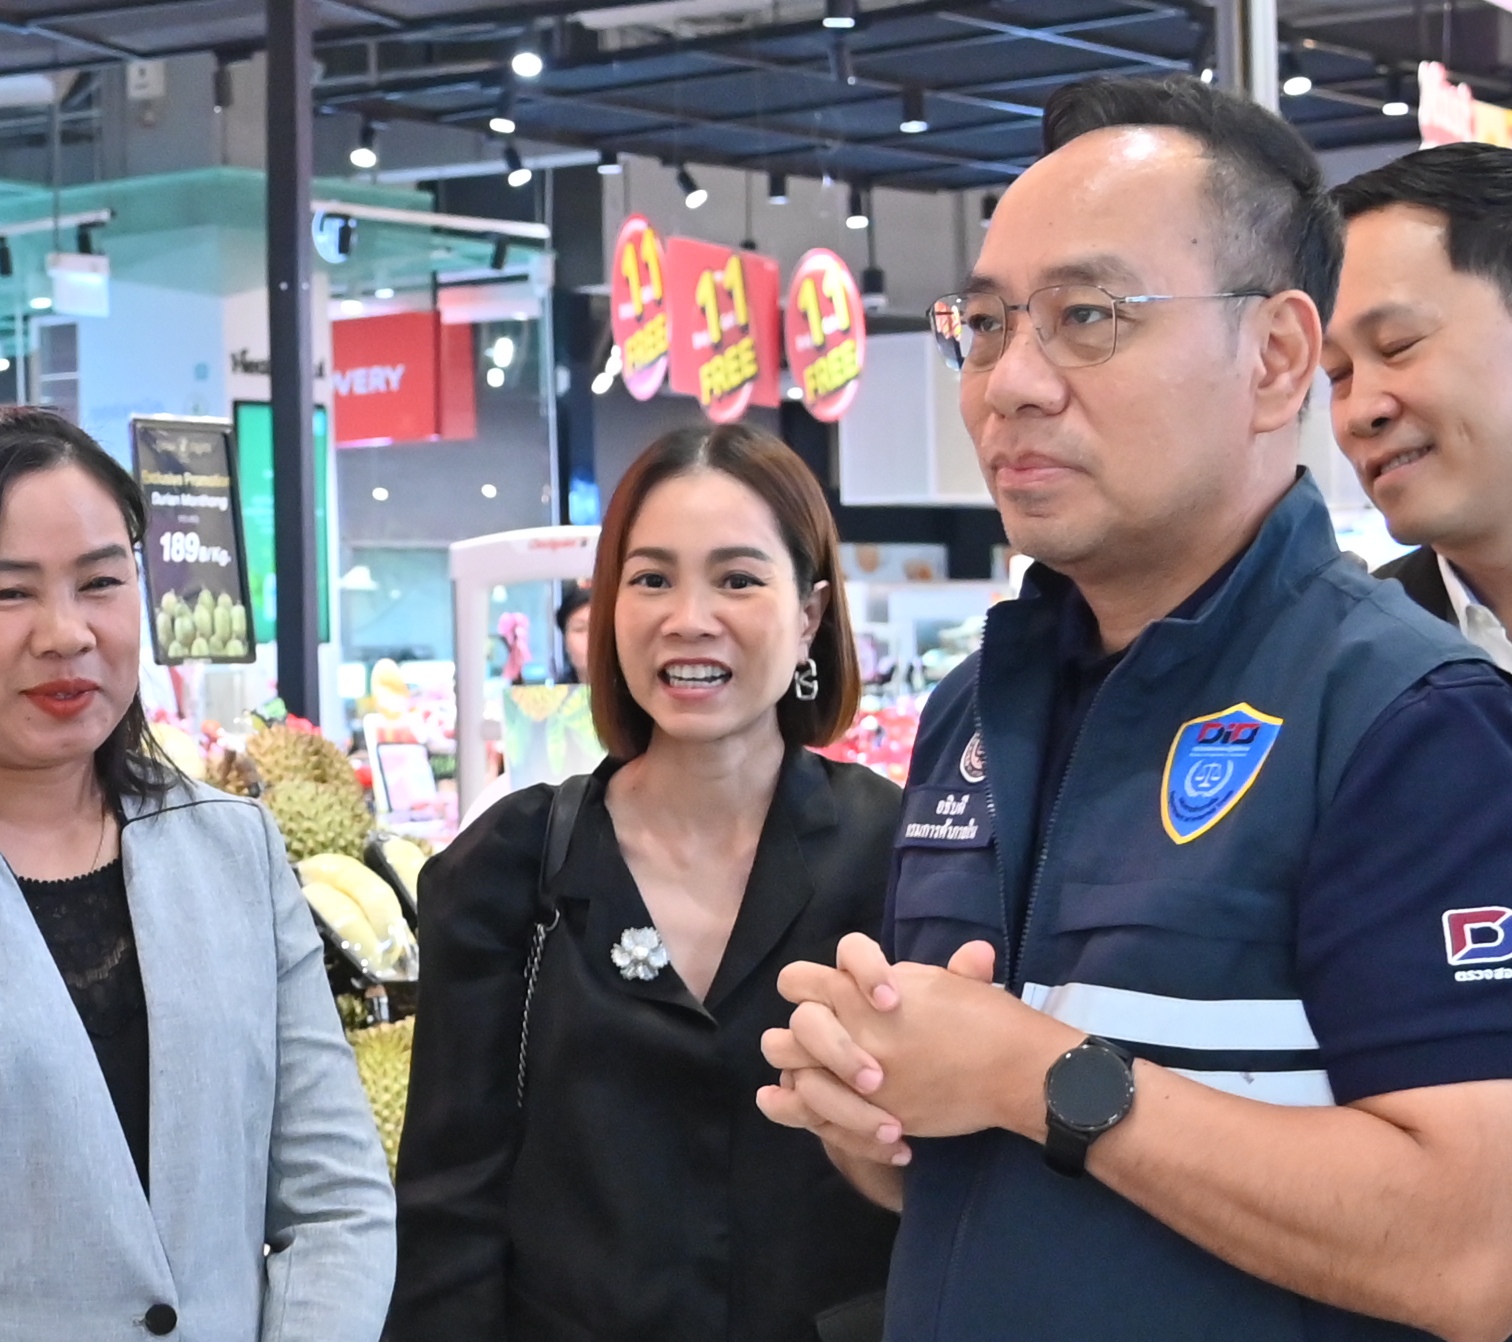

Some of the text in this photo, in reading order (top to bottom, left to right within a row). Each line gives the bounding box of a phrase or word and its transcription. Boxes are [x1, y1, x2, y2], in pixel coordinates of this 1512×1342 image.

[624, 312, 668, 377] FREE
[699, 337, 758, 405] FREE
[804, 339, 860, 402] FREE
